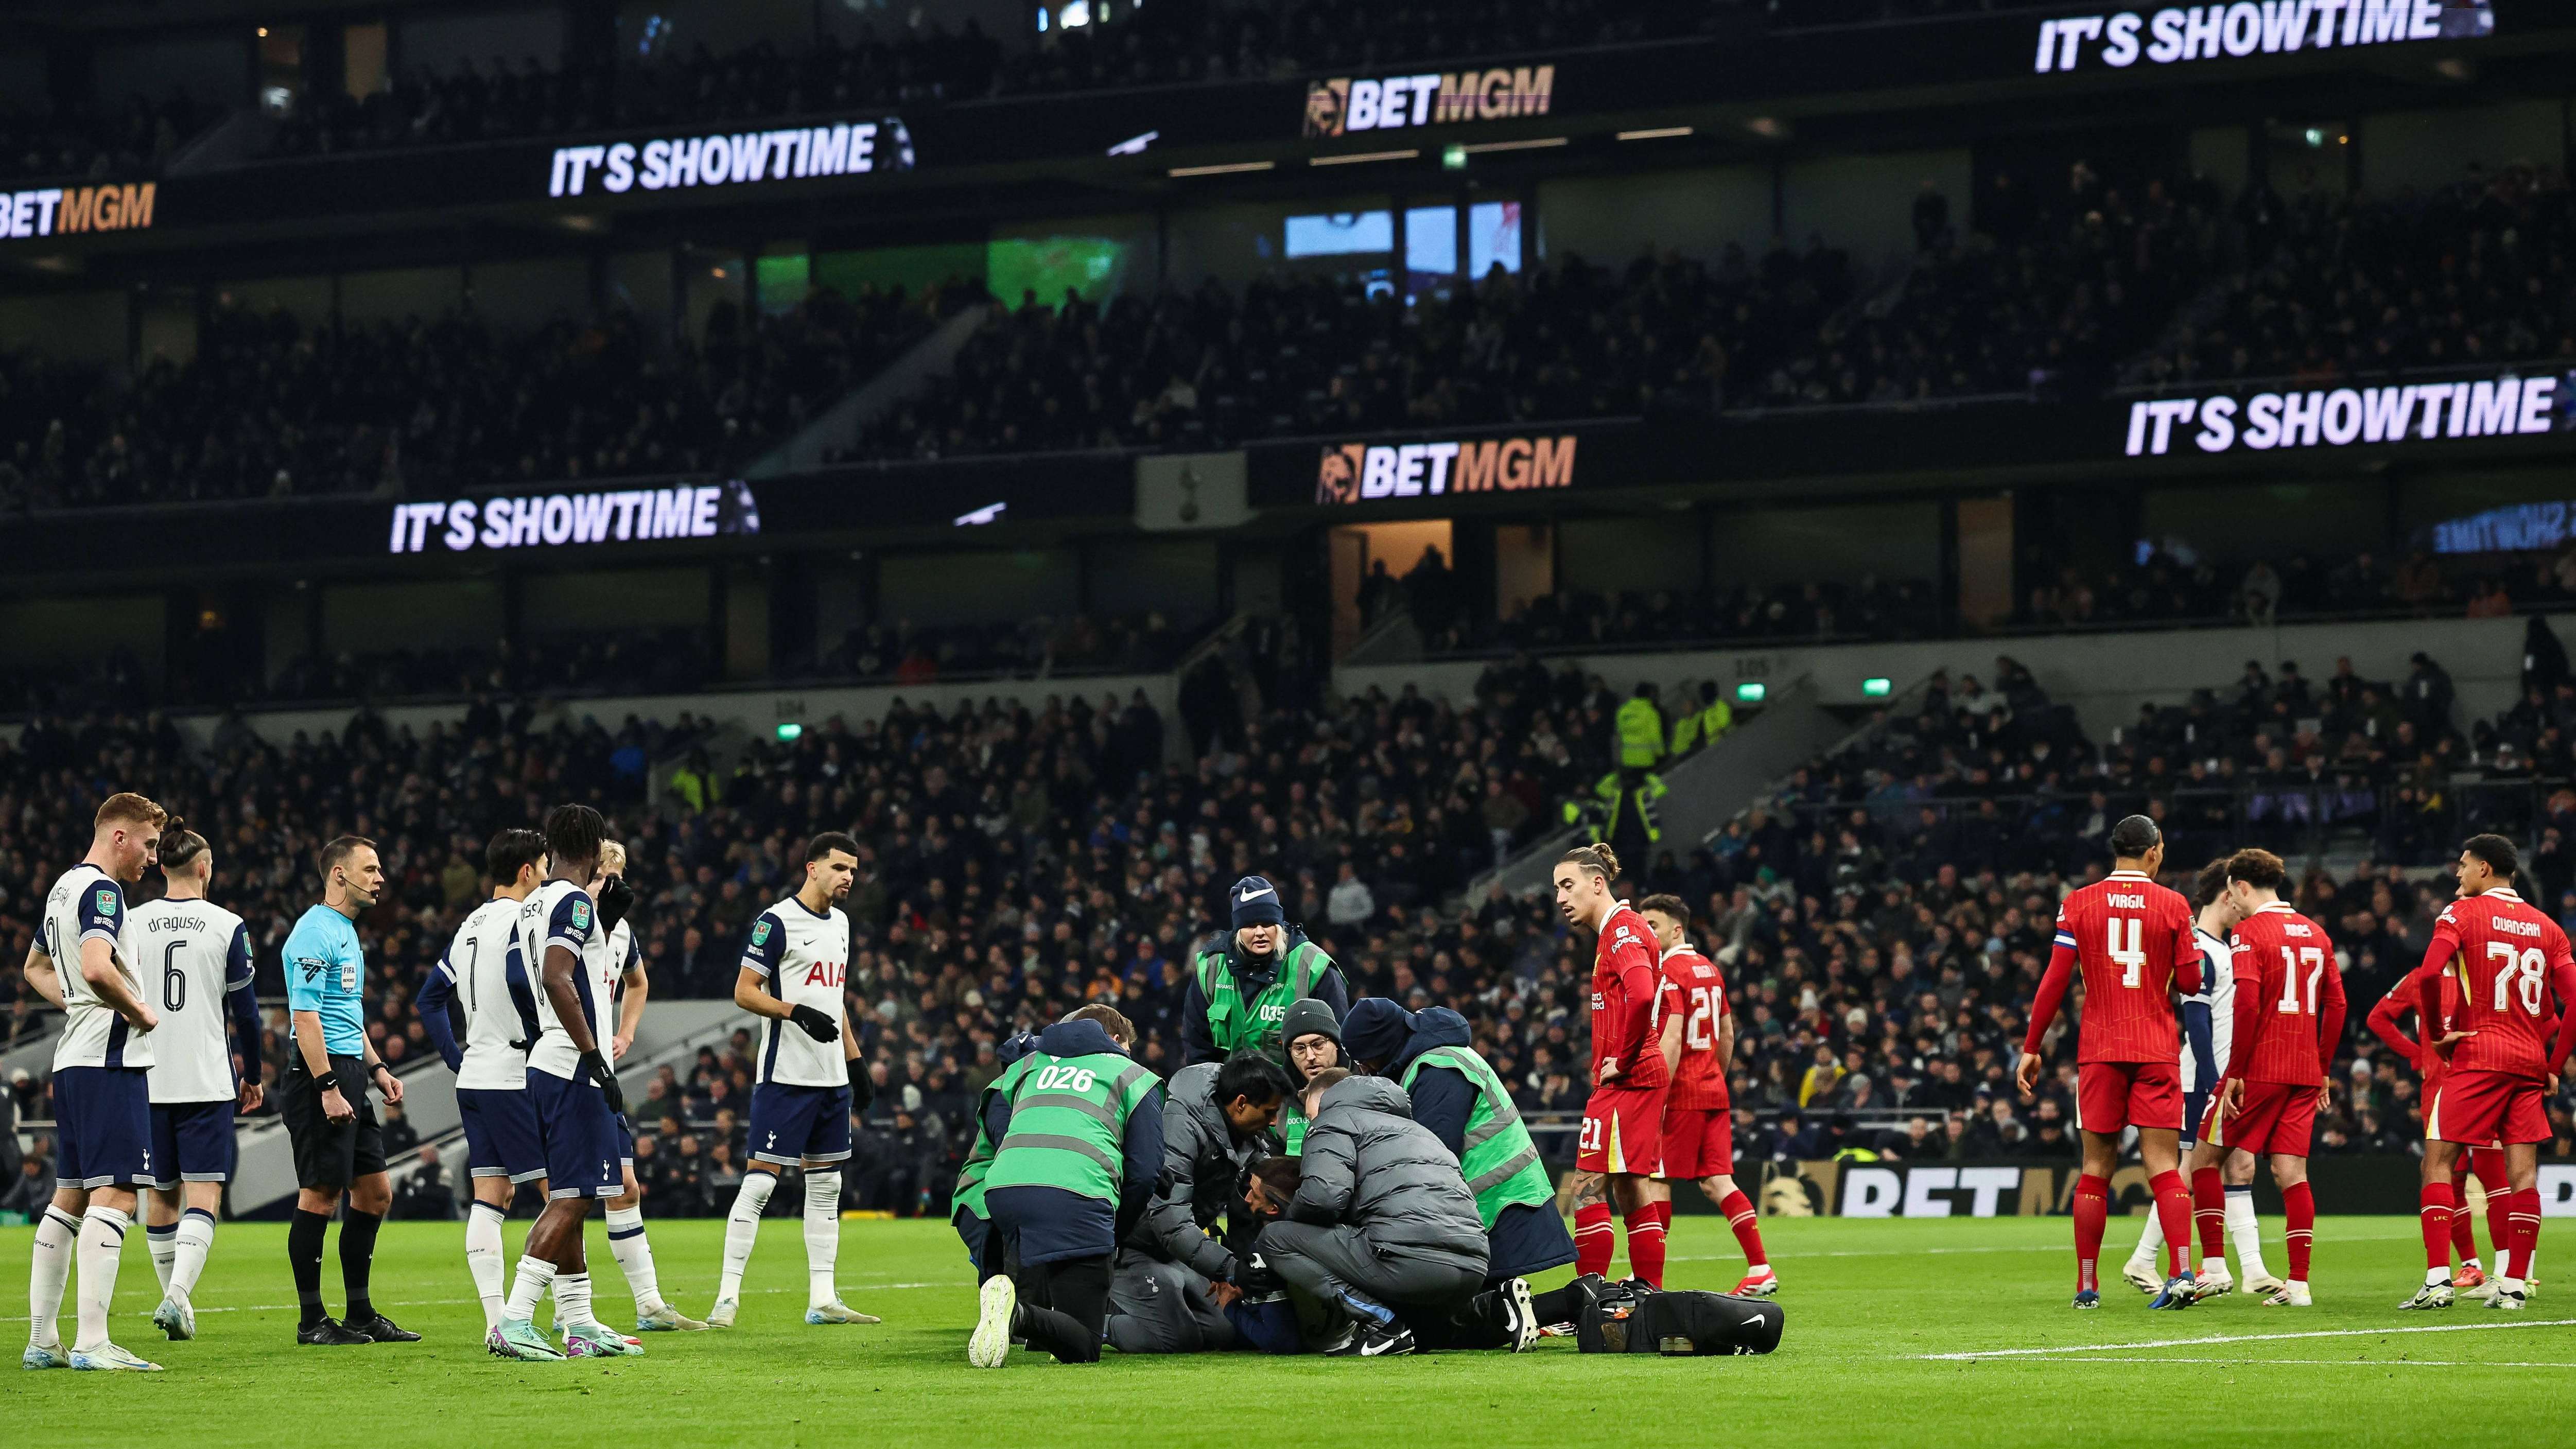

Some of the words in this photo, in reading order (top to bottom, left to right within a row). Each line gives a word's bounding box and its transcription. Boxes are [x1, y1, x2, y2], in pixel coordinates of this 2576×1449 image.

[2035, 13, 2142, 73] IT'S
[2146, 0, 2443, 63] SHOWTIME
[549, 143, 637, 198] IT'S
[639, 124, 877, 190] SHOWTIME
[2126, 396, 2237, 456] IT'S
[2242, 377, 2557, 449] SHOWTIME
[1361, 436, 1577, 498] BETMGM
[390, 500, 478, 553] IT'S
[480, 486, 722, 548] SHOWTIME
[2107, 893, 2146, 910] VIRGIL
[163, 940, 187, 1012] 6
[466, 936, 478, 1012] 7
[805, 961, 846, 988] AIA
[2108, 917, 2147, 989] 4
[2278, 945, 2325, 1016] 17
[2487, 940, 2547, 1018] 78
[1260, 1004, 1286, 1022] 035
[1686, 986, 1722, 1051] 20
[1036, 1064, 1097, 1093] 026
[1579, 1116, 1603, 1151] 21
